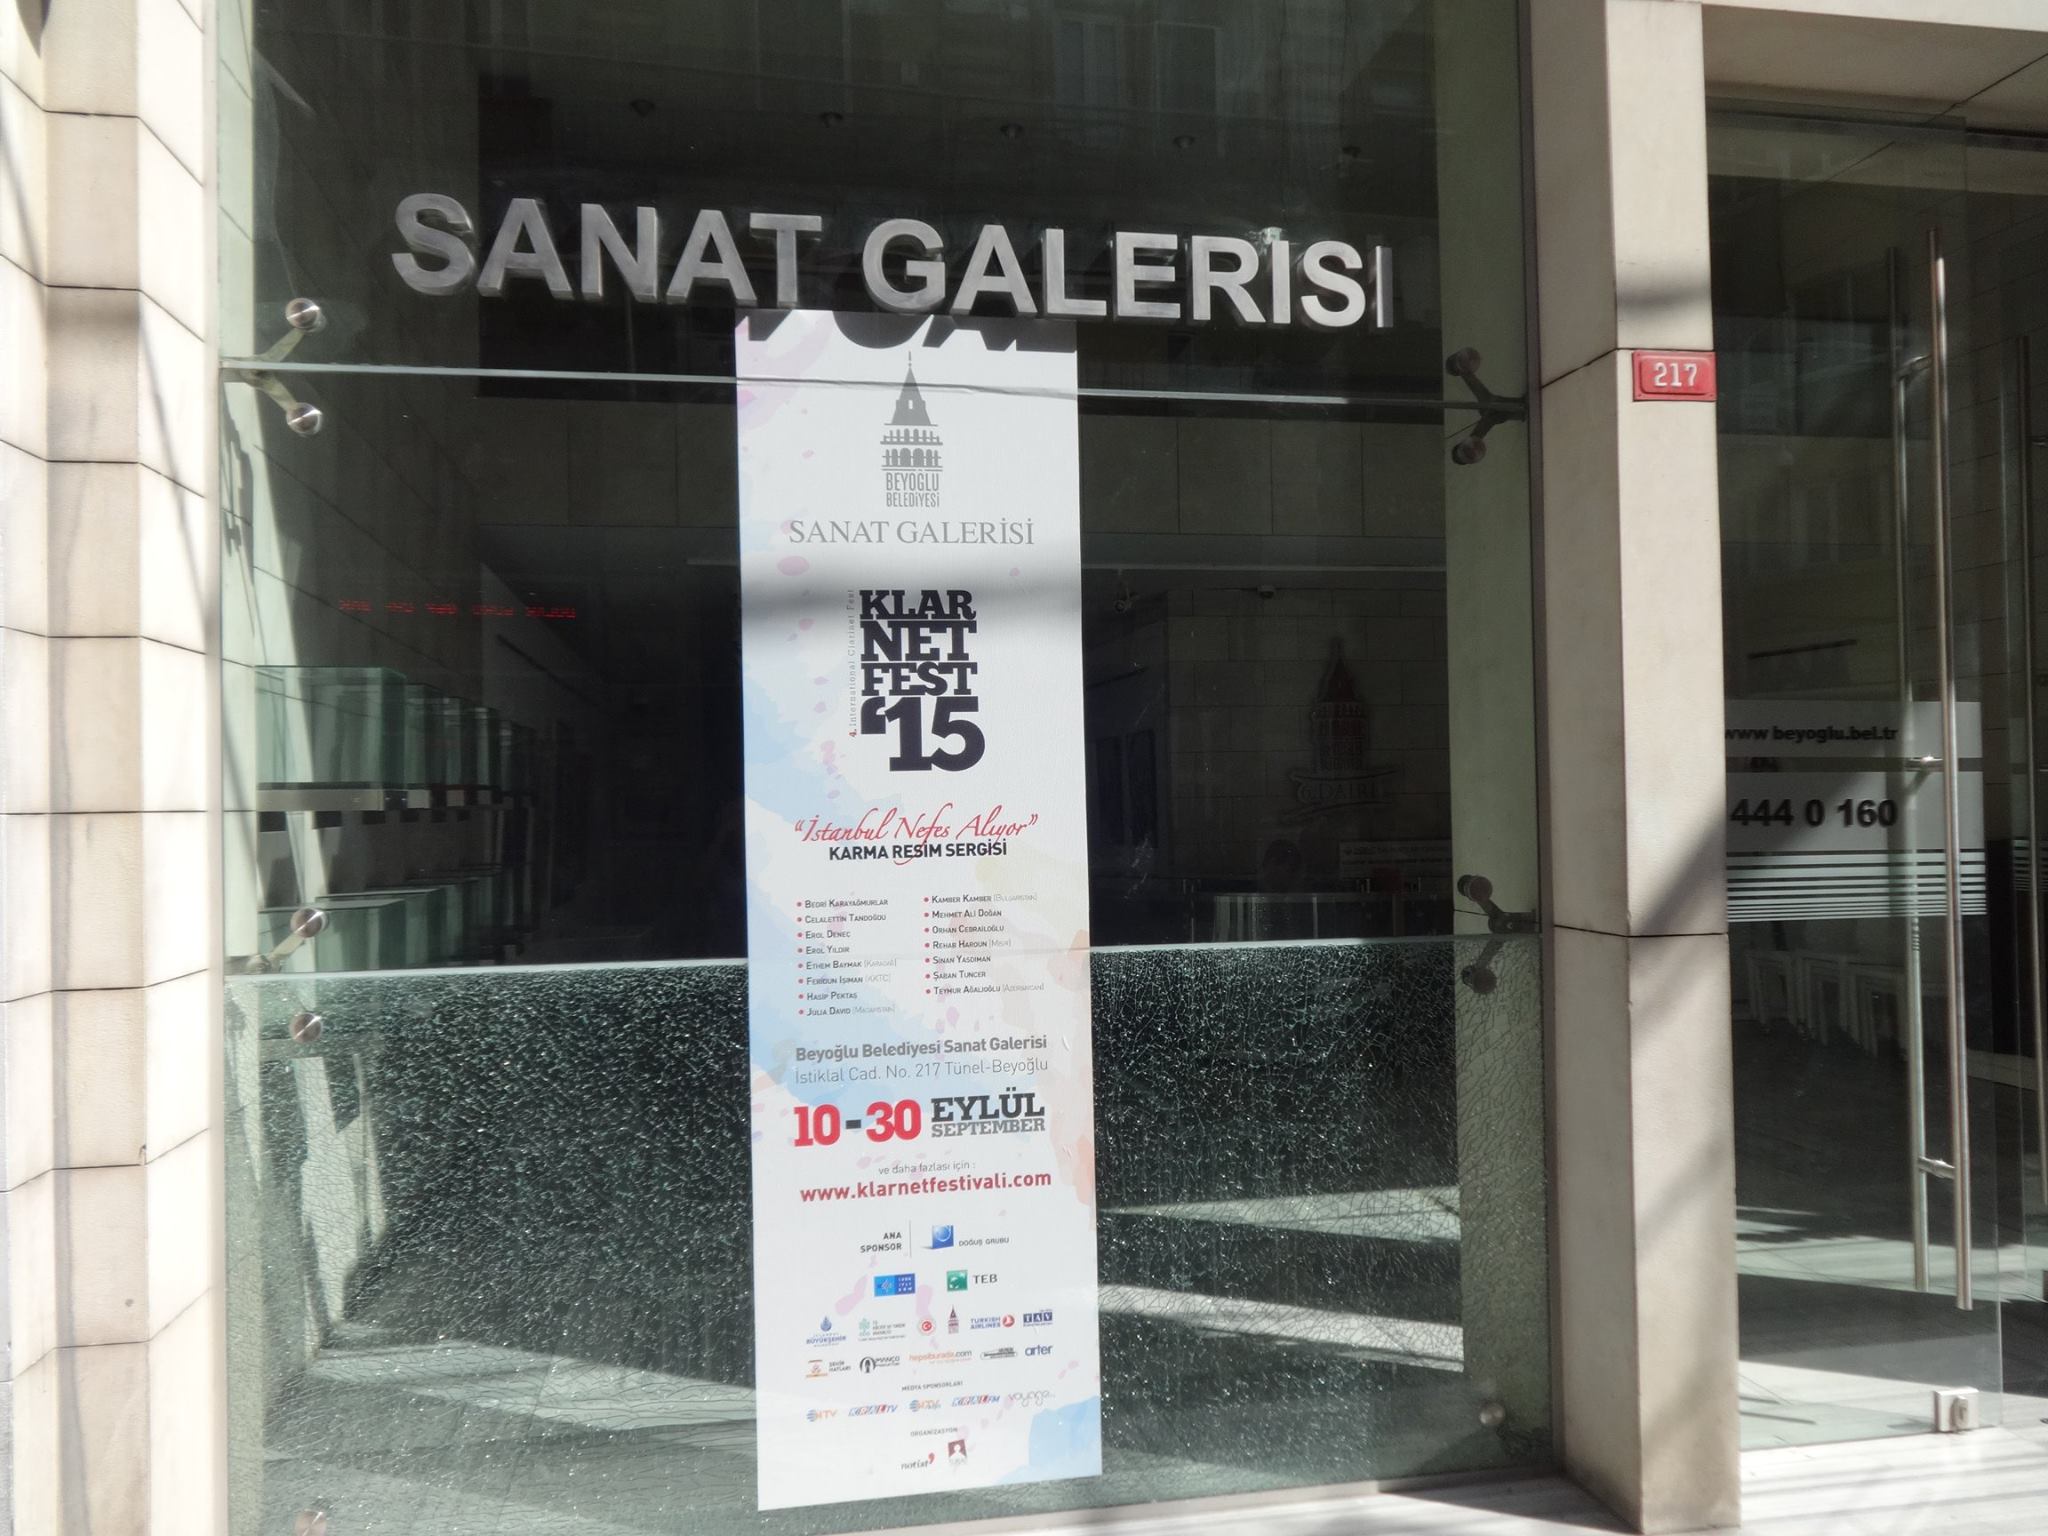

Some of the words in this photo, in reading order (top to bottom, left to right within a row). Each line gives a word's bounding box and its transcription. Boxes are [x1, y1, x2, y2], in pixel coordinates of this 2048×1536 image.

[392, 192, 822, 308] SANAT
[1654, 362, 1697, 387] 217
[886, 469, 939, 491] BEYOĞLU
[886, 492, 940, 508] BELEDİYESİ
[789, 520, 889, 543] SANAT
[897, 518, 1035, 545] GALERİSİ
[859, 590, 977, 620] KLAR
[860, 620, 977, 662] NET
[861, 661, 978, 696] FEST
[1730, 799, 1794, 826] 444
[1805, 799, 1825, 827] 0
[1837, 798, 1898, 828] 160
[893, 802, 954, 865] Nefes
[829, 846, 889, 860] KARMA
[892, 841, 942, 858] RESİM
[945, 838, 1007, 857] SERGİSİ
[795, 1045, 858, 1064] Beyoğlu
[862, 1040, 941, 1059] Belediyesi
[944, 1038, 987, 1053] Sanat
[989, 1035, 1047, 1051] Galerisi
[795, 1068, 843, 1084] İstiklal
[849, 1066, 881, 1081] Cad.
[886, 1065, 911, 1080] No.
[916, 1063, 940, 1078] 217
[945, 1057, 1048, 1076] Tünel-Beyoğlu
[931, 1086, 1045, 1123] EYLÜL
[931, 1117, 1046, 1138] SEPTEMBER
[800, 1173, 1052, 1203] www.klarnetfestivali.com
[860, 1242, 902, 1254] SPONSOR
[882, 1231, 902, 1241] ANA
[972, 1274, 998, 1285] TEB
[1024, 1344, 1053, 1357] arter
